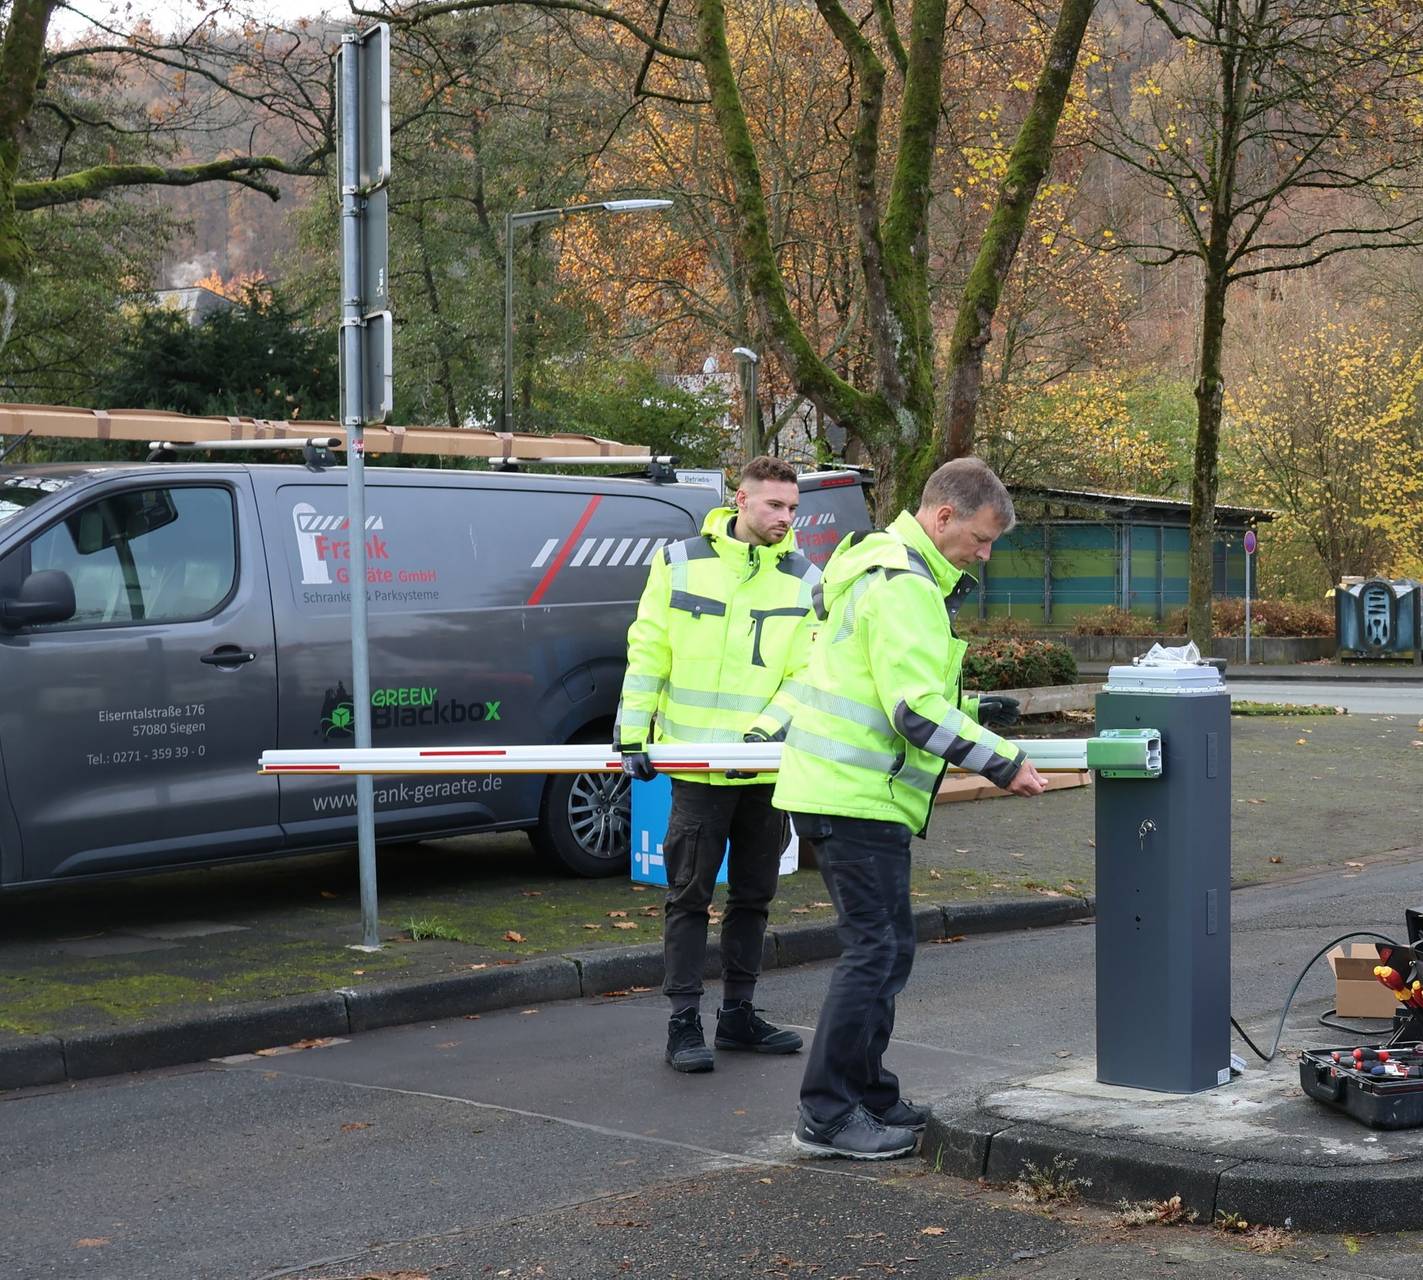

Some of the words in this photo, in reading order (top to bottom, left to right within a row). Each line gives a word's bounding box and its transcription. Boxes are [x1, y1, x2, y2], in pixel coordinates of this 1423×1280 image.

[336, 566, 393, 583] Gäte
[399, 569, 437, 583] GmbH
[303, 591, 351, 604] Schranke
[375, 589, 440, 603] Parksysteme
[98, 705, 182, 721] Eiserntalstraße
[185, 704, 205, 716] 176
[370, 699, 501, 730] Blackbox
[132, 723, 168, 737] 57080
[170, 722, 206, 735] Siegen
[87, 752, 110, 765] Tel.:
[113, 751, 141, 763] 0271
[151, 747, 172, 760] 359
[175, 746, 189, 758] 39
[198, 745, 206, 756] 0
[313, 774, 502, 811] wwwrank-geraete.de
